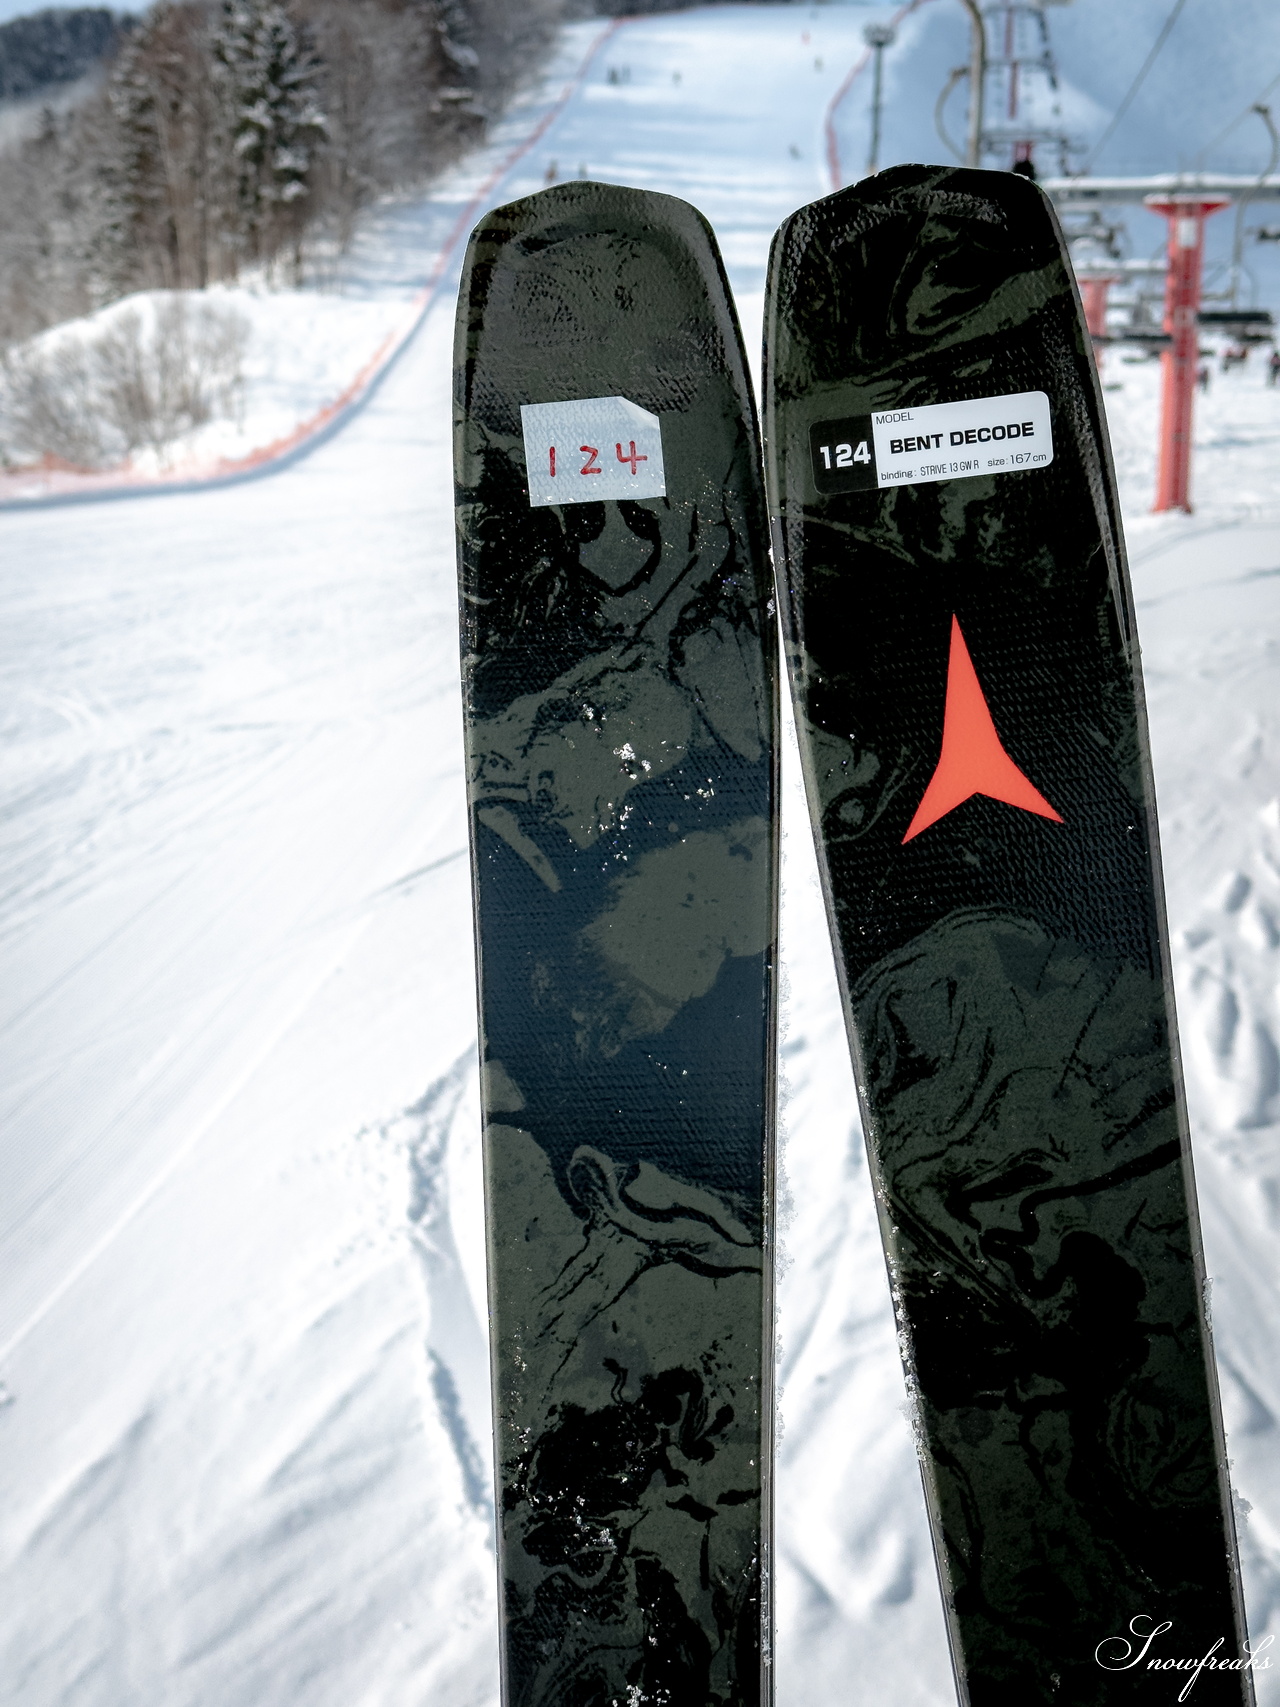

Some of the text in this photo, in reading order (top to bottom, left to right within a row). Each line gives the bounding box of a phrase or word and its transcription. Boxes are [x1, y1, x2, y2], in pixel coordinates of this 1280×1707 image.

[876, 412, 914, 425] MODEL
[890, 422, 1035, 454] BENT DECODE
[549, 440, 648, 477] 124
[820, 441, 871, 469] 124
[881, 469, 917, 481] binding:
[920, 464, 947, 476] STRIVE
[949, 462, 959, 473] 13
